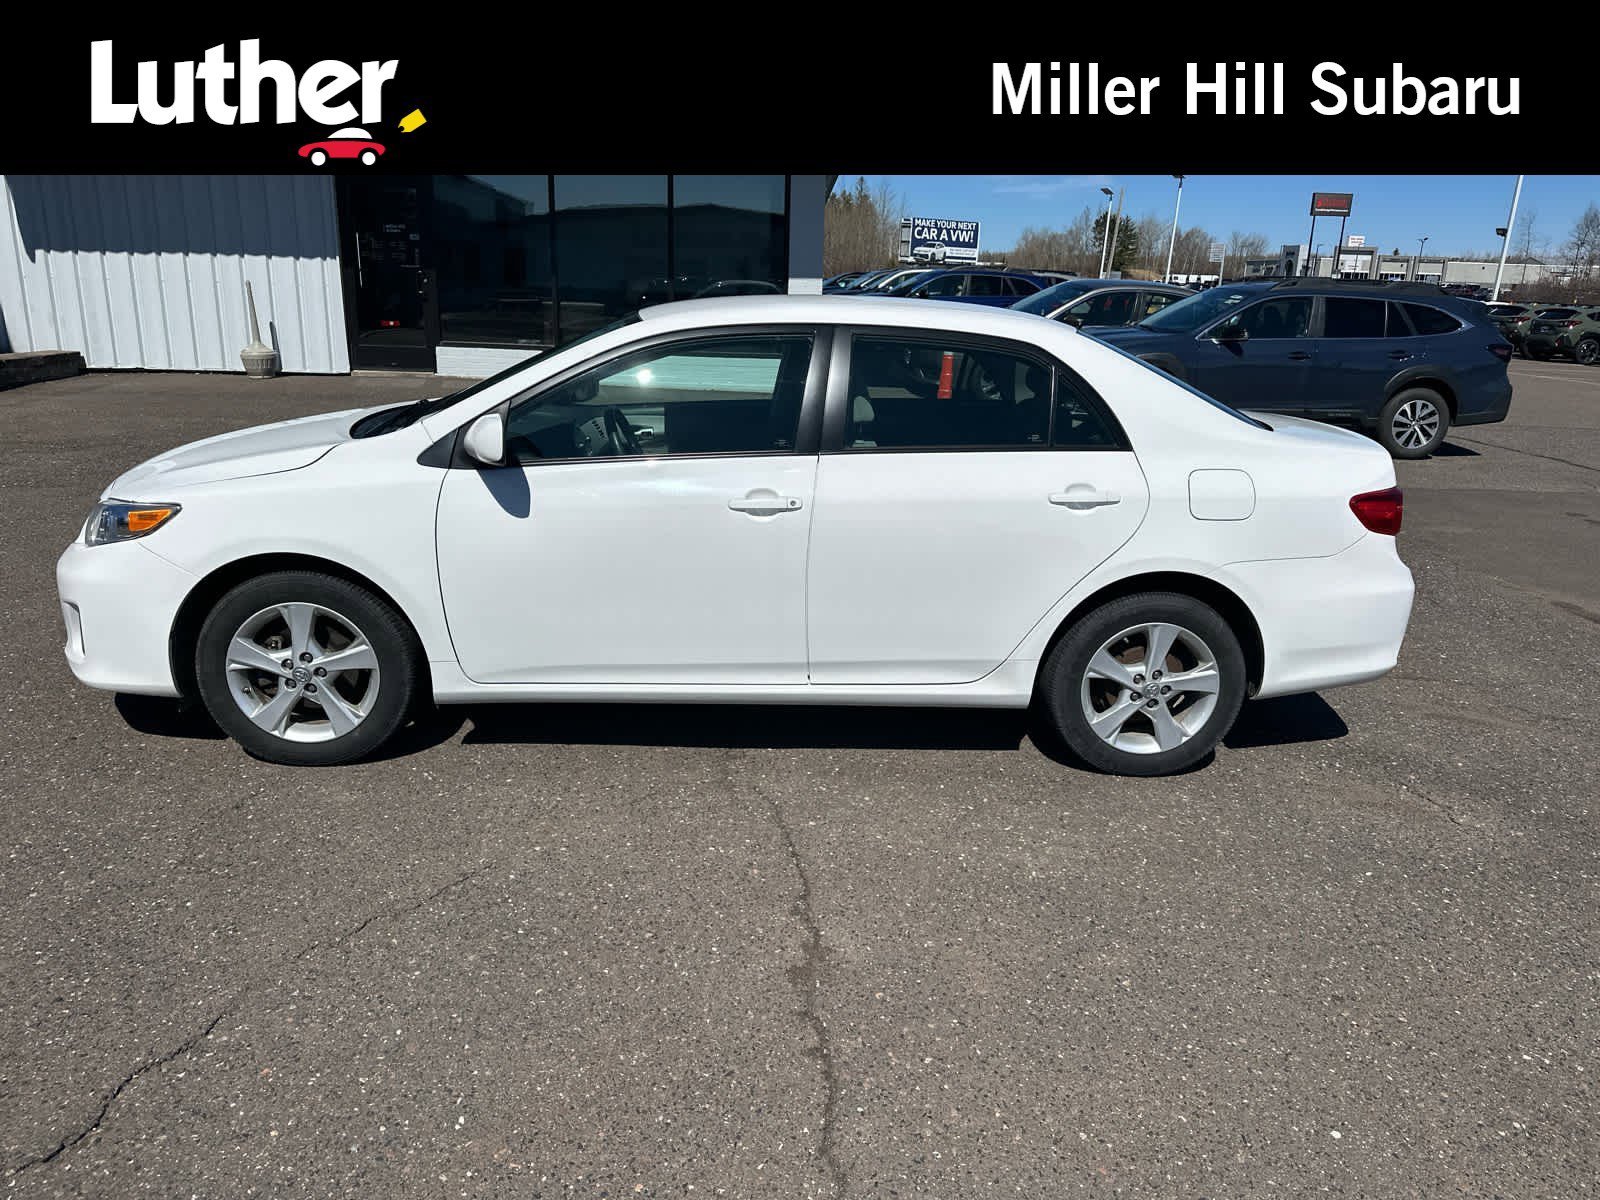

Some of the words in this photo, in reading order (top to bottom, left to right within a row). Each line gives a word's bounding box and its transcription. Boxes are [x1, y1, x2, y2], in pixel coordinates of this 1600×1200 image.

[914, 218, 936, 228] MAKE
[937, 220, 957, 230] YOUR
[958, 222, 977, 231] NEXT
[914, 227, 938, 240] CAR
[940, 229, 949, 241] A
[950, 230, 974, 243] VW!
